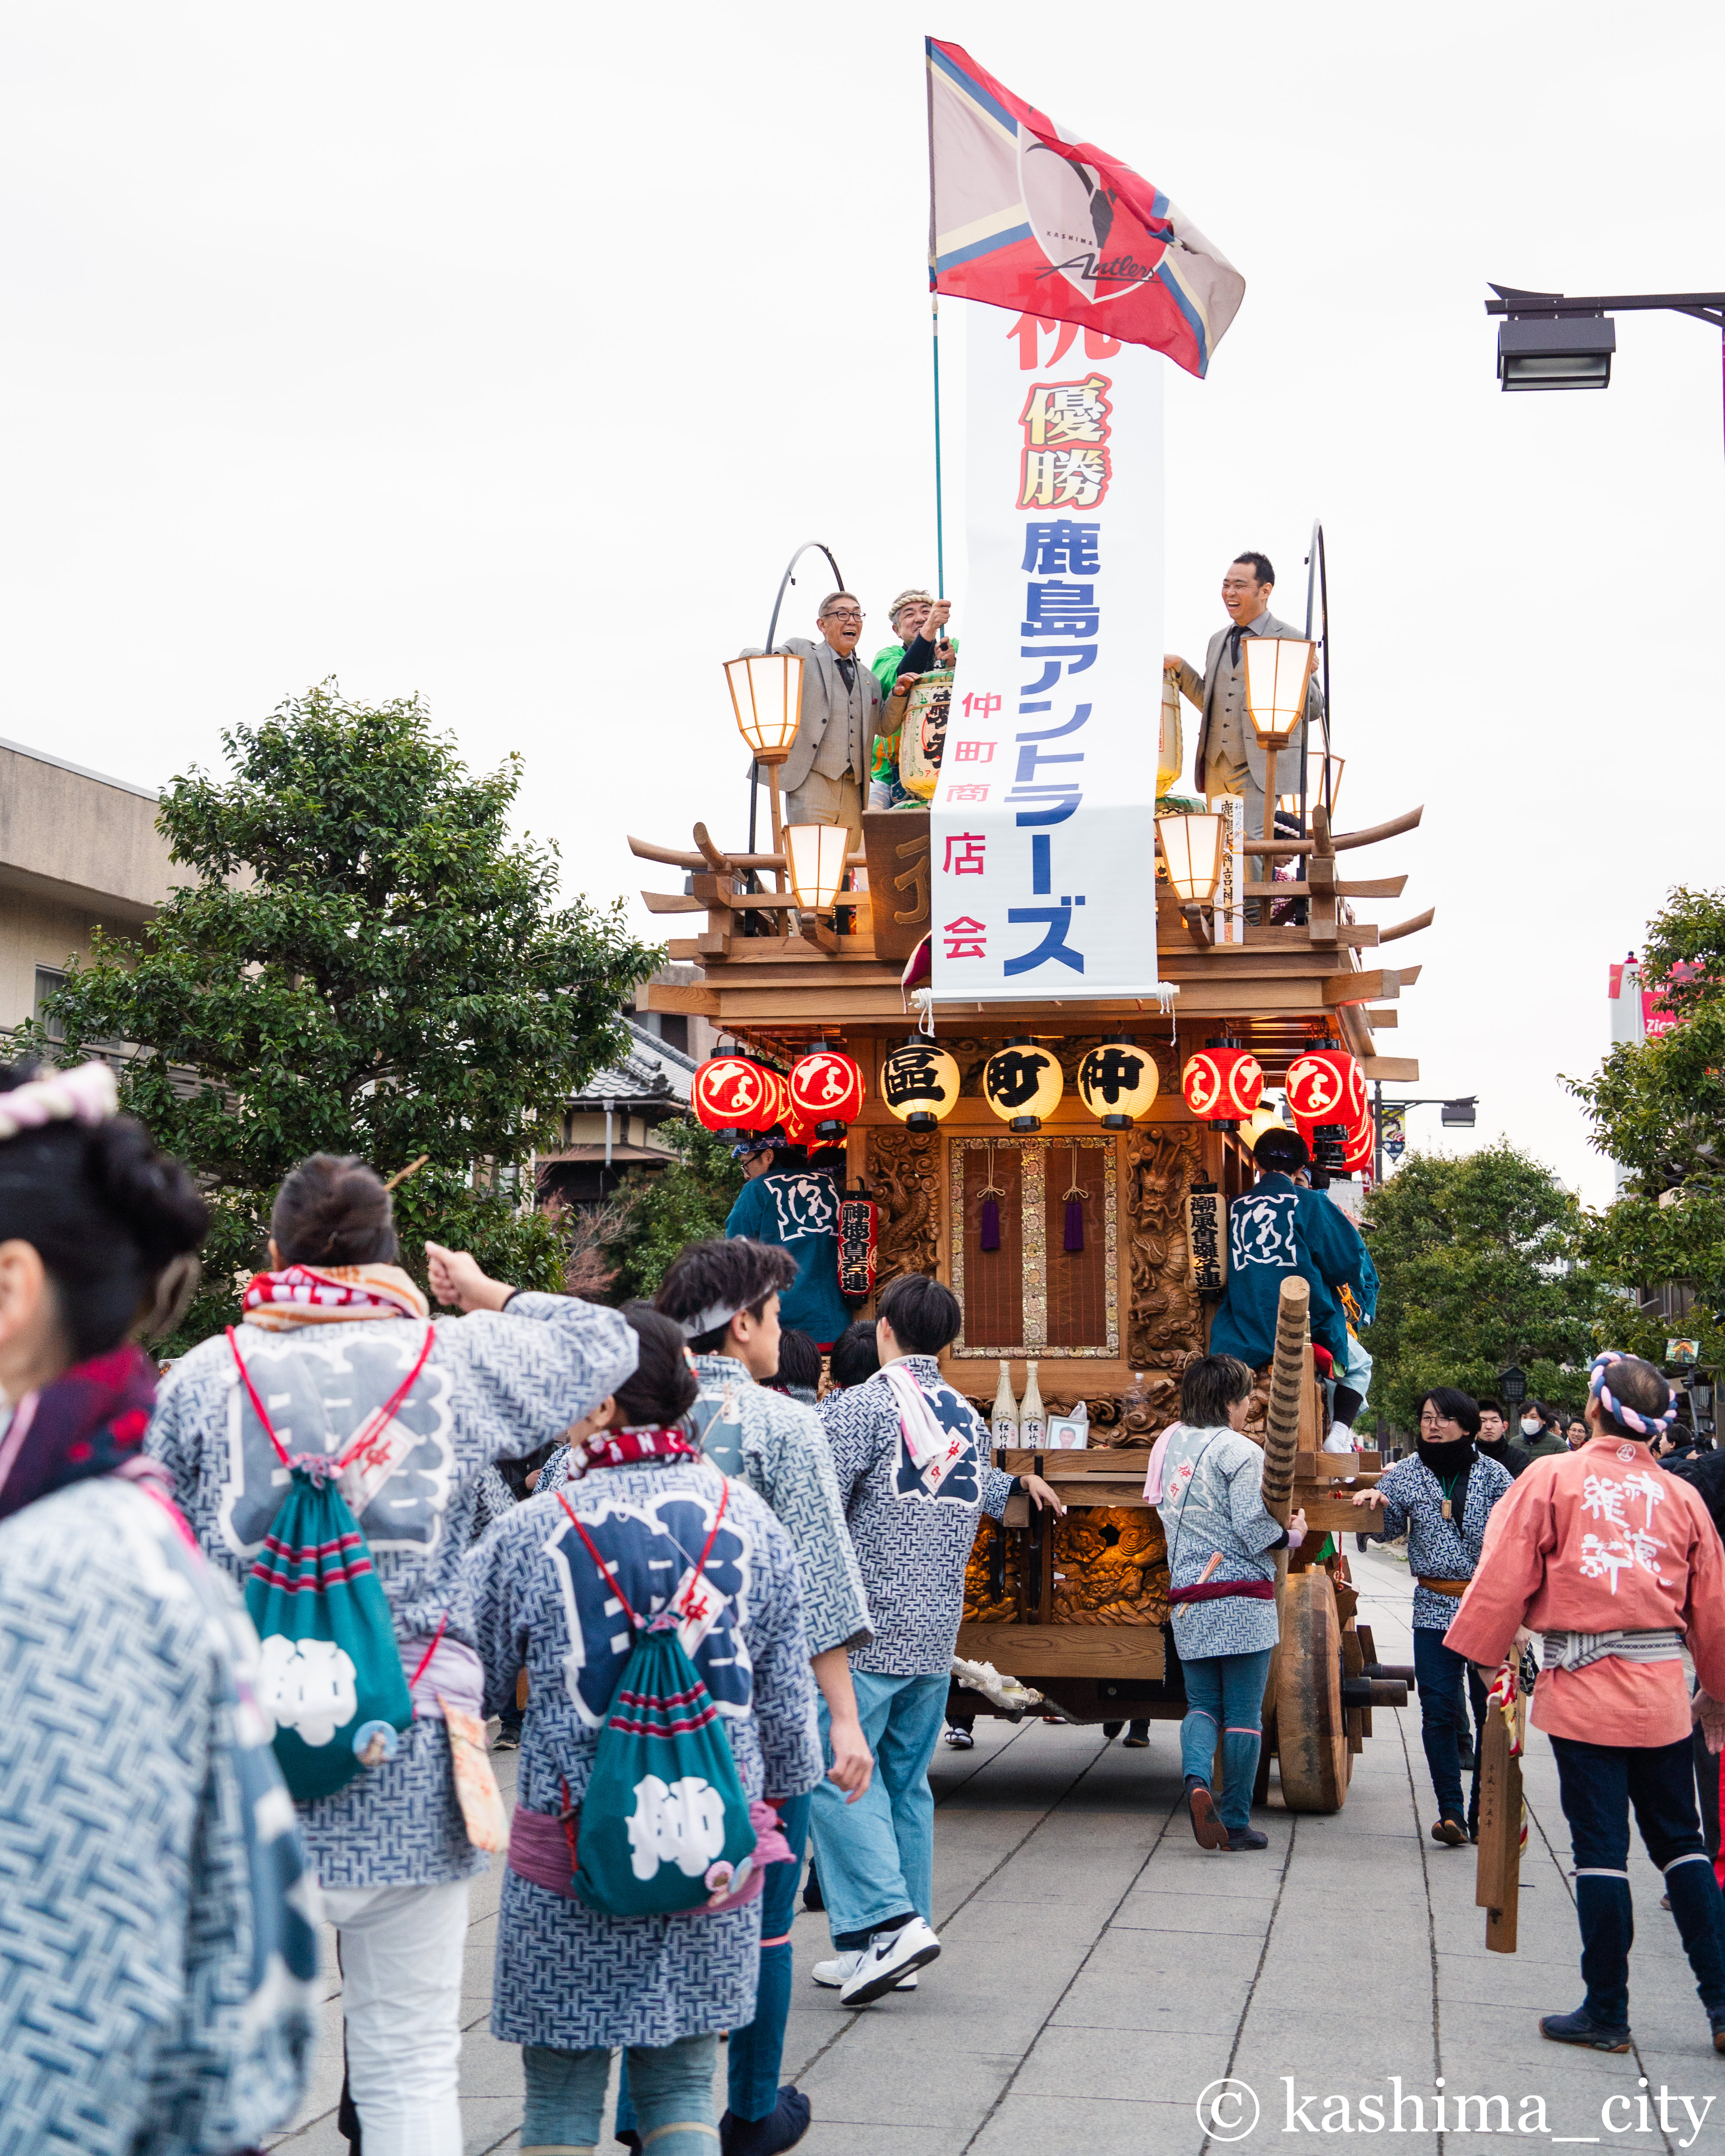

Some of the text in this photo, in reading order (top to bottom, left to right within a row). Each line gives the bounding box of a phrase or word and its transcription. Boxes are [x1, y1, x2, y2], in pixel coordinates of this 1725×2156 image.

[1047, 231, 1093, 246] KASHIMA
[1034, 253, 1162, 283] Antlers
[943, 692, 1001, 959] 仲町商店会
[708, 1063, 753, 1108] な
[797, 1057, 845, 1100] な
[986, 1050, 1051, 1107] 町
[1288, 1060, 1331, 1108] な
